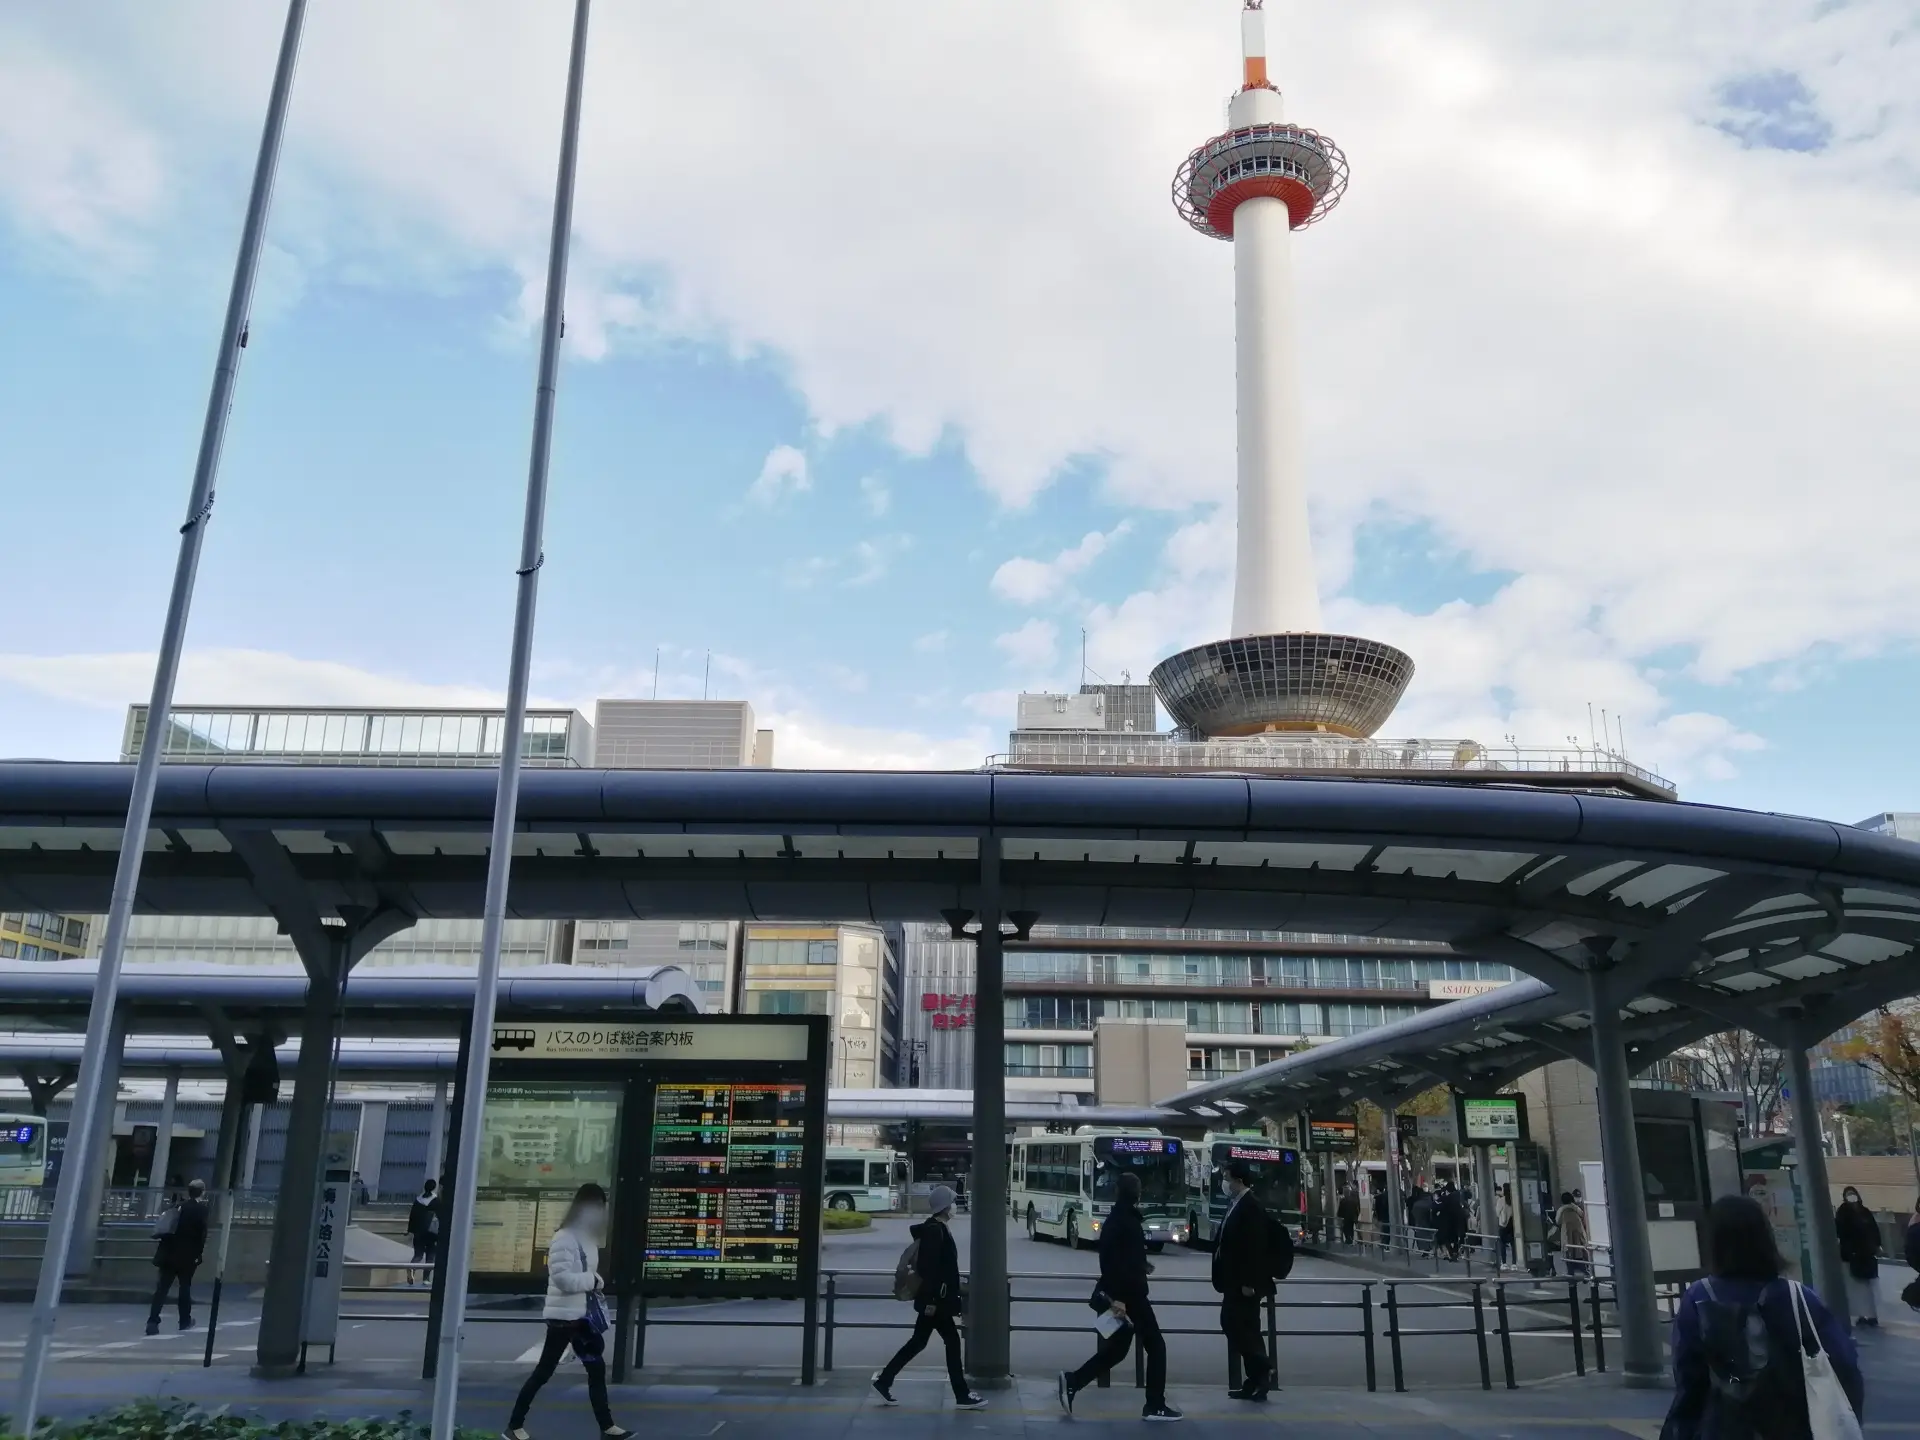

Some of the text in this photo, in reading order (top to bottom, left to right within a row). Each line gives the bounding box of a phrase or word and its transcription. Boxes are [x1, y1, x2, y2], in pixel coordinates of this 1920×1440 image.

[546, 1030, 695, 1046] バスのりば総合案内板
